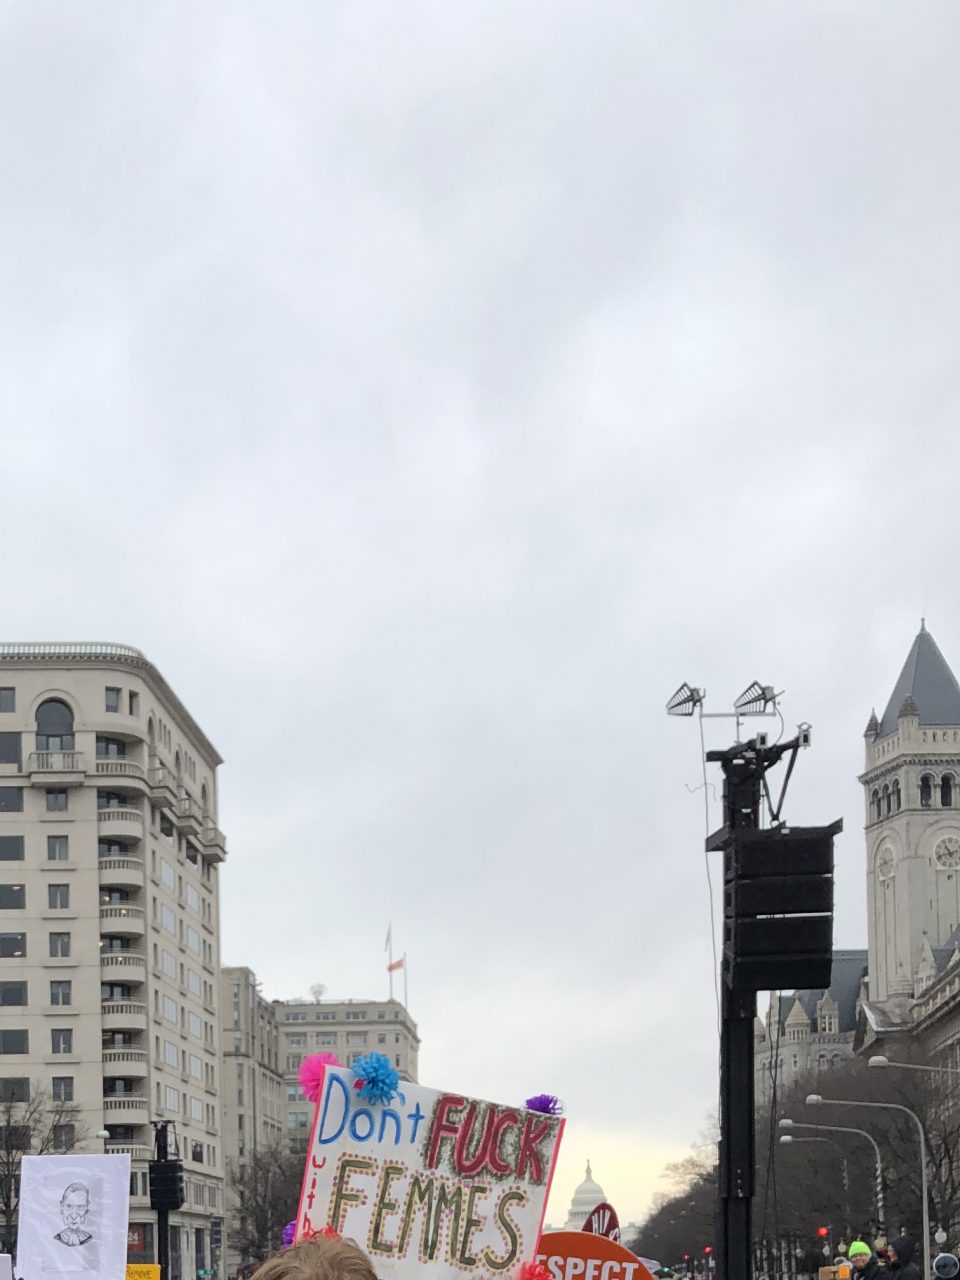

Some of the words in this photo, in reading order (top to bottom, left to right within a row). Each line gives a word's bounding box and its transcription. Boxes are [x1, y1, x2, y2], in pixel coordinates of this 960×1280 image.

[426, 1095, 553, 1182] FUCK
[302, 1155, 327, 1230] with
[329, 1156, 528, 1271] FEMMES
